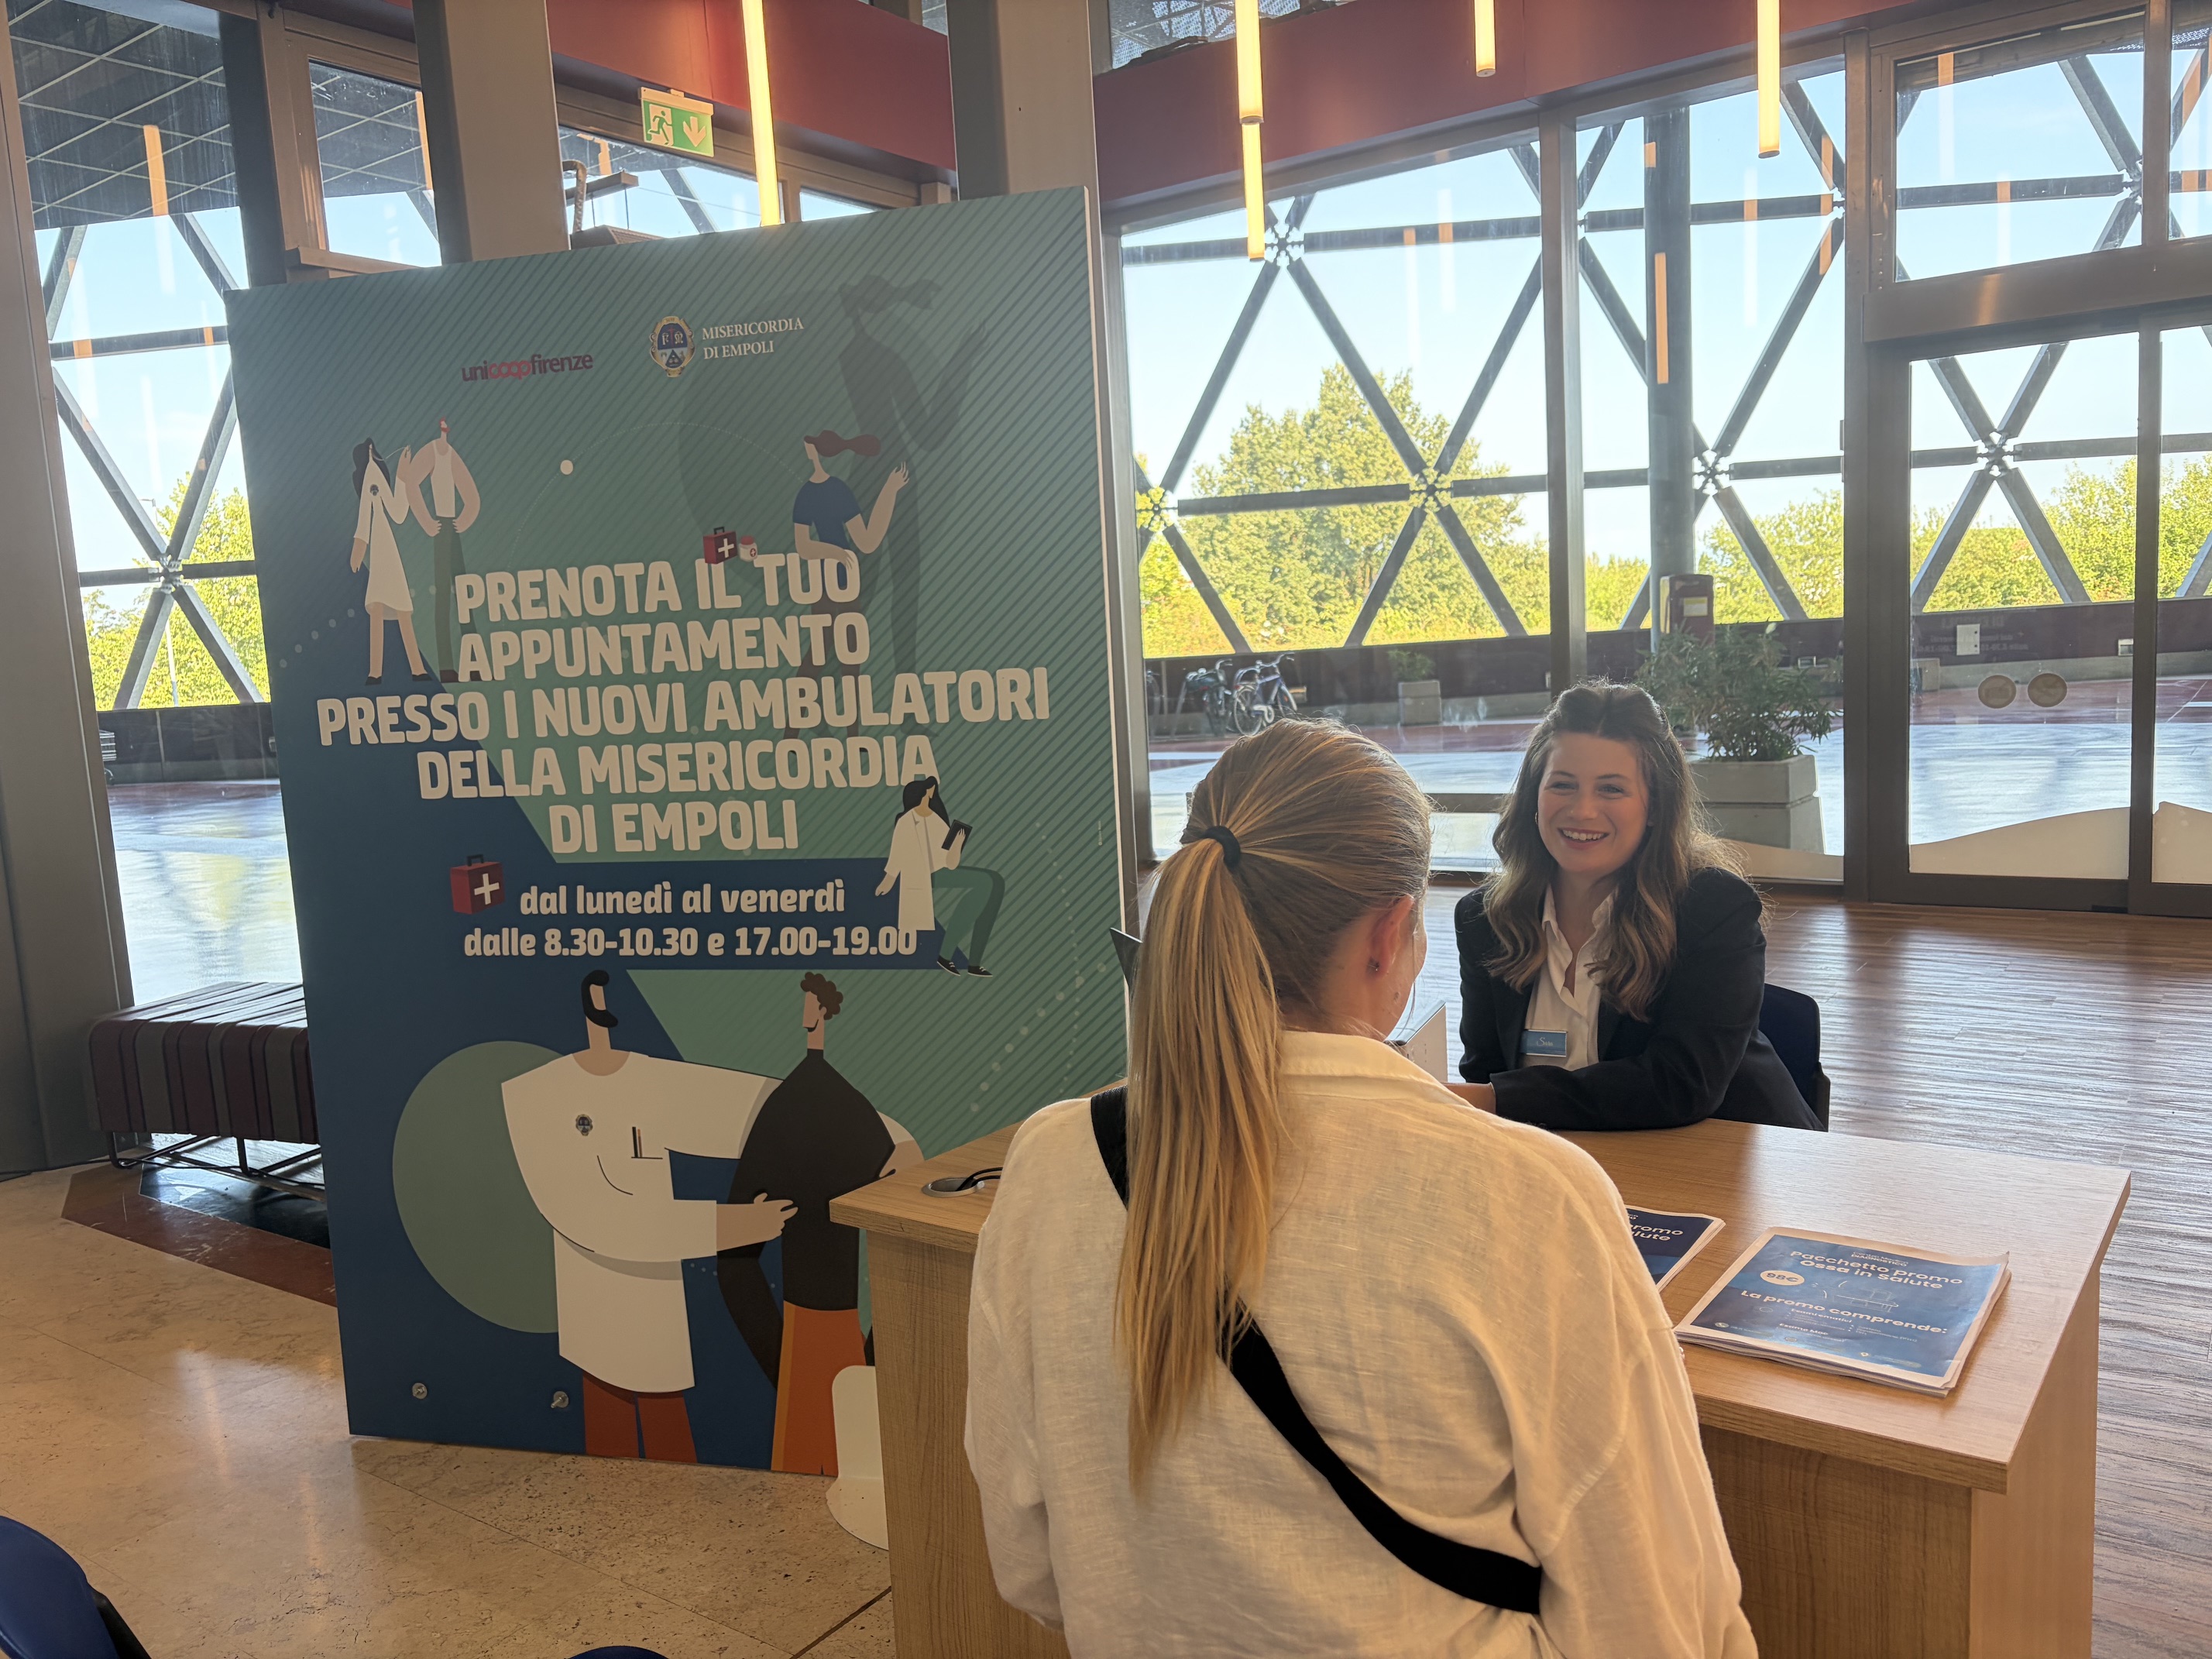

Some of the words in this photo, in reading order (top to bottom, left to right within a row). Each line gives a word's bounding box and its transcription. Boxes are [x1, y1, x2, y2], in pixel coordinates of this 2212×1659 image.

[702, 318, 804, 341] MISERICORDIA
[703, 345, 721, 360] DI
[722, 340, 774, 359] EMPOLI
[455, 561, 682, 623] PRENOTA
[695, 557, 742, 610] IL
[753, 549, 860, 606] TUO
[458, 612, 871, 682] APPUNTAMENTO
[317, 692, 489, 746] PRESSO
[503, 690, 519, 739] I
[532, 682, 688, 738] NUOVI
[704, 667, 1049, 732] AMBULATORI
[417, 747, 567, 799] DELLA
[578, 735, 940, 795] MISERICORDIA
[548, 805, 598, 854] DI
[612, 799, 799, 853] EMPOLI
[520, 885, 568, 915] dal
[576, 881, 672, 915] lunedì
[682, 883, 712, 914] al
[720, 878, 845, 913] venerdì
[465, 927, 536, 957] dalle
[544, 926, 699, 957] 8.30-10.30
[707, 932, 725, 956] e
[735, 926, 918, 956] 17.00-19.00
[1790, 1251, 1890, 1273] Pacchetto
[1892, 1269, 1963, 1284] promo
[1800, 1260, 1850, 1273] Ossa
[1854, 1266, 1872, 1278] in
[1741, 1290, 1762, 1299] La
[1764, 1296, 1826, 1311] promo
[1829, 1307, 1948, 1334] comprende:
